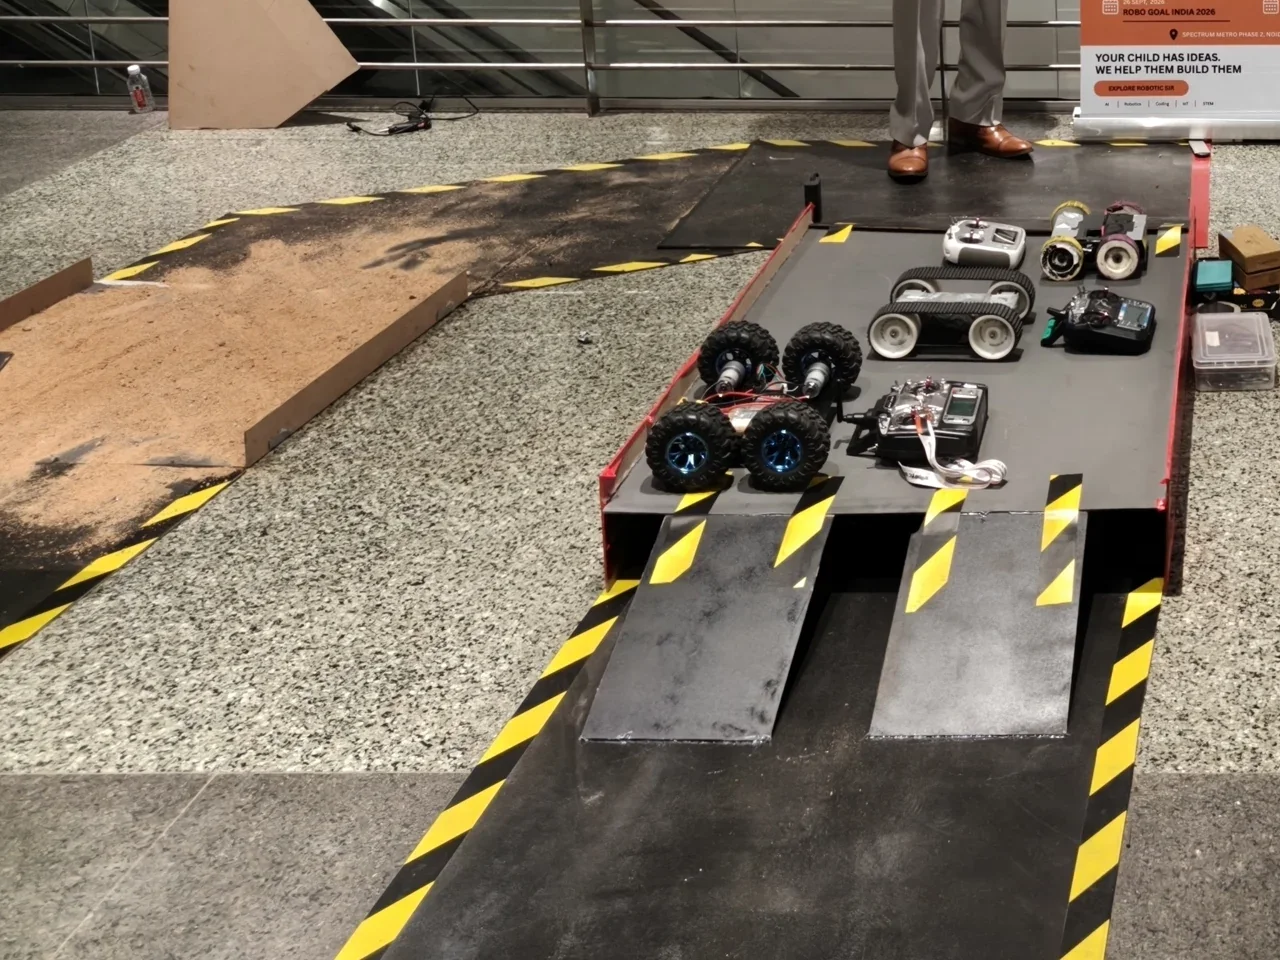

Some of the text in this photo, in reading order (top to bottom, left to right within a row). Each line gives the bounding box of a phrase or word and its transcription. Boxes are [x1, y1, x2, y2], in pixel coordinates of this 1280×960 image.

[1122, 8, 1216, 16] ROBO GOAL INDIA 2026
[1095, 53, 1221, 62] YOUR CHILD HAS IDEAS.
[1095, 65, 1242, 74] WE HELP THEM BUILD THEM
